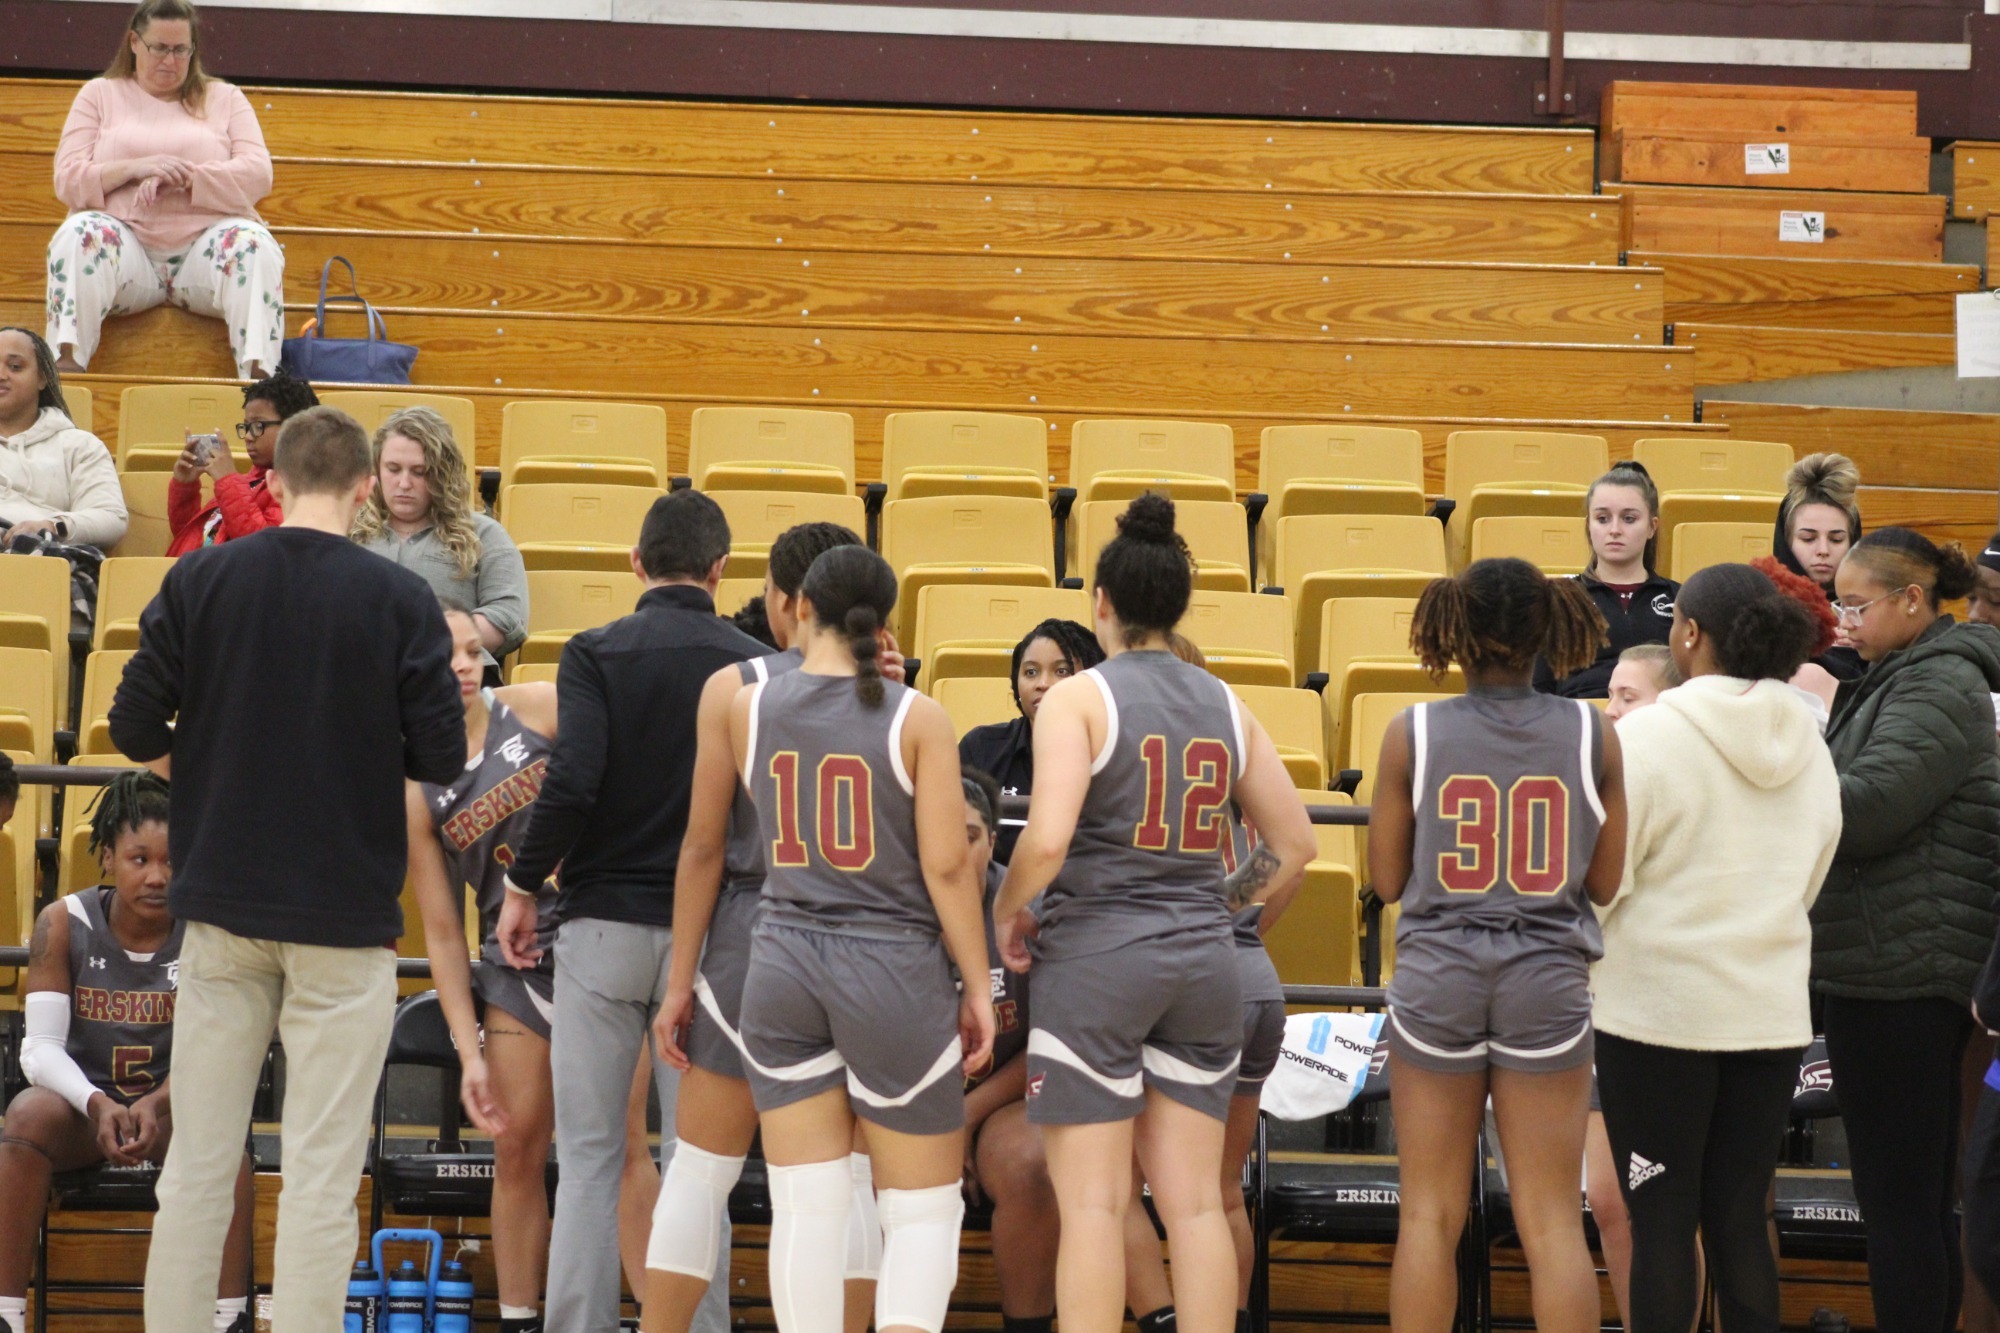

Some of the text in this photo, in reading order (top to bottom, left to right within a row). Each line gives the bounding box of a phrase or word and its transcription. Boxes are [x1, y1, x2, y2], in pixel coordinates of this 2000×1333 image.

[770, 750, 875, 871] 10
[1133, 734, 1231, 853] 12
[1438, 774, 1569, 896] 30
[112, 1045, 156, 1097] 5
[436, 1164, 496, 1178] ERSKI
[1629, 1163, 1666, 1190] adidas
[1793, 1206, 1864, 1223] ERSKIN
